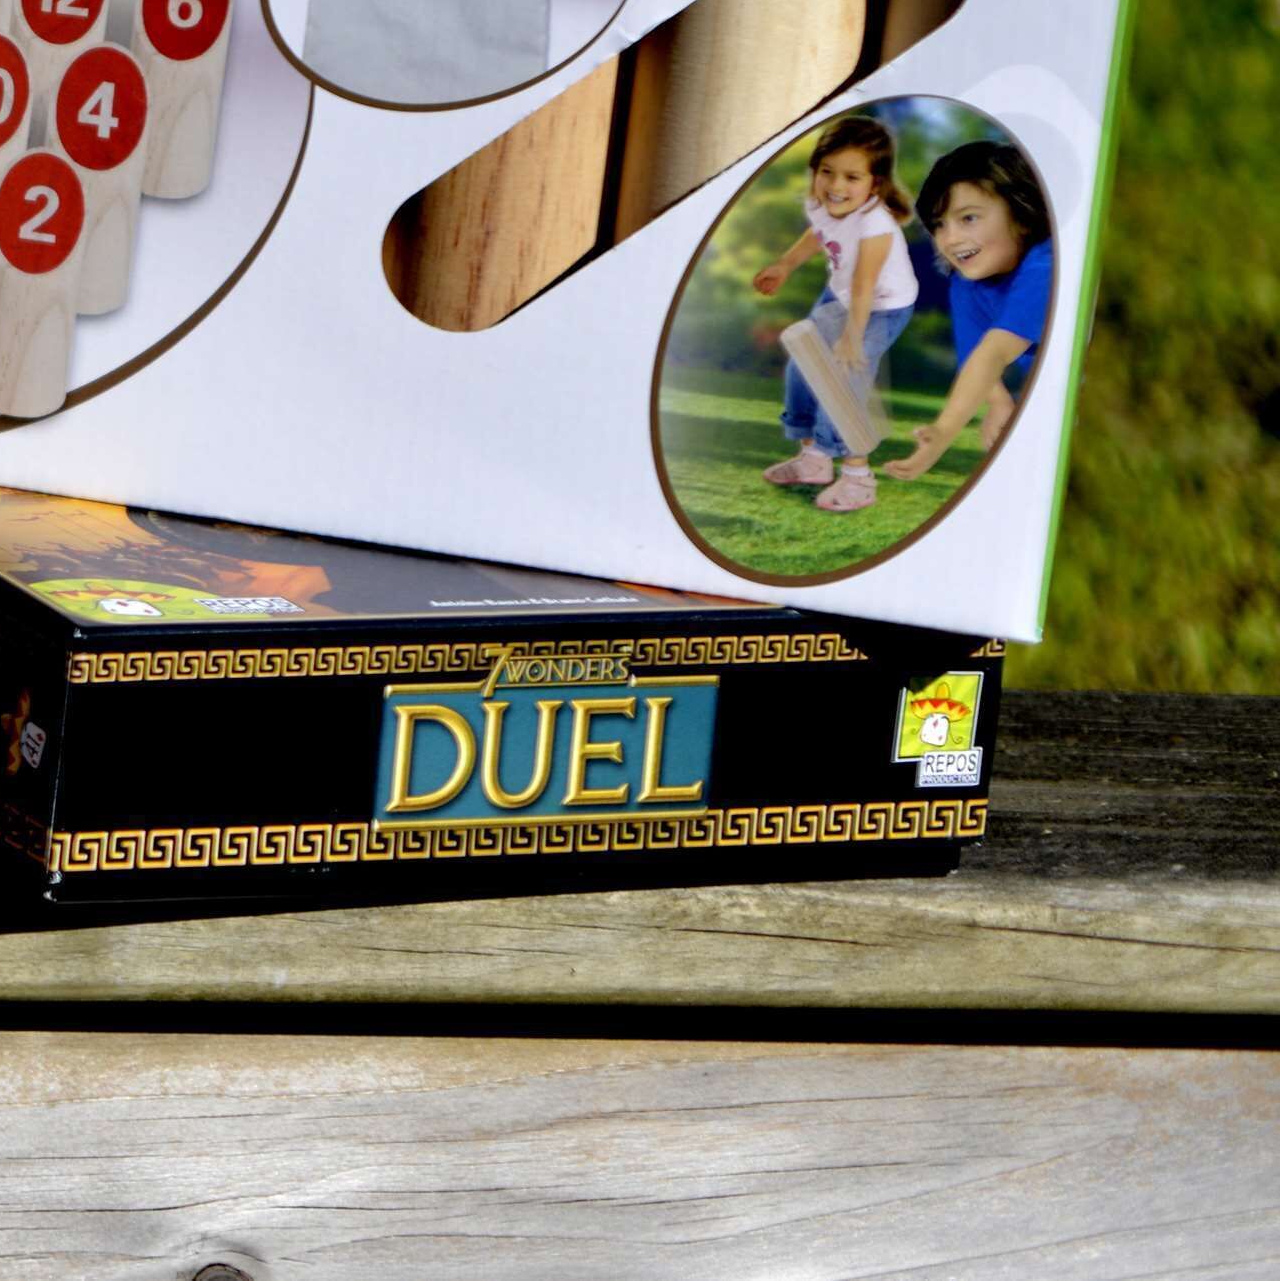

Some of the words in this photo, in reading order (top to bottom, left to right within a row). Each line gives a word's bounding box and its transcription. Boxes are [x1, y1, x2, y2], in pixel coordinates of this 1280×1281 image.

[77, 81, 119, 139] 4
[20, 185, 58, 245] 2
[505, 657, 631, 683] WONDERS
[385, 696, 704, 814] DUEL
[924, 753, 978, 773] REPOS
